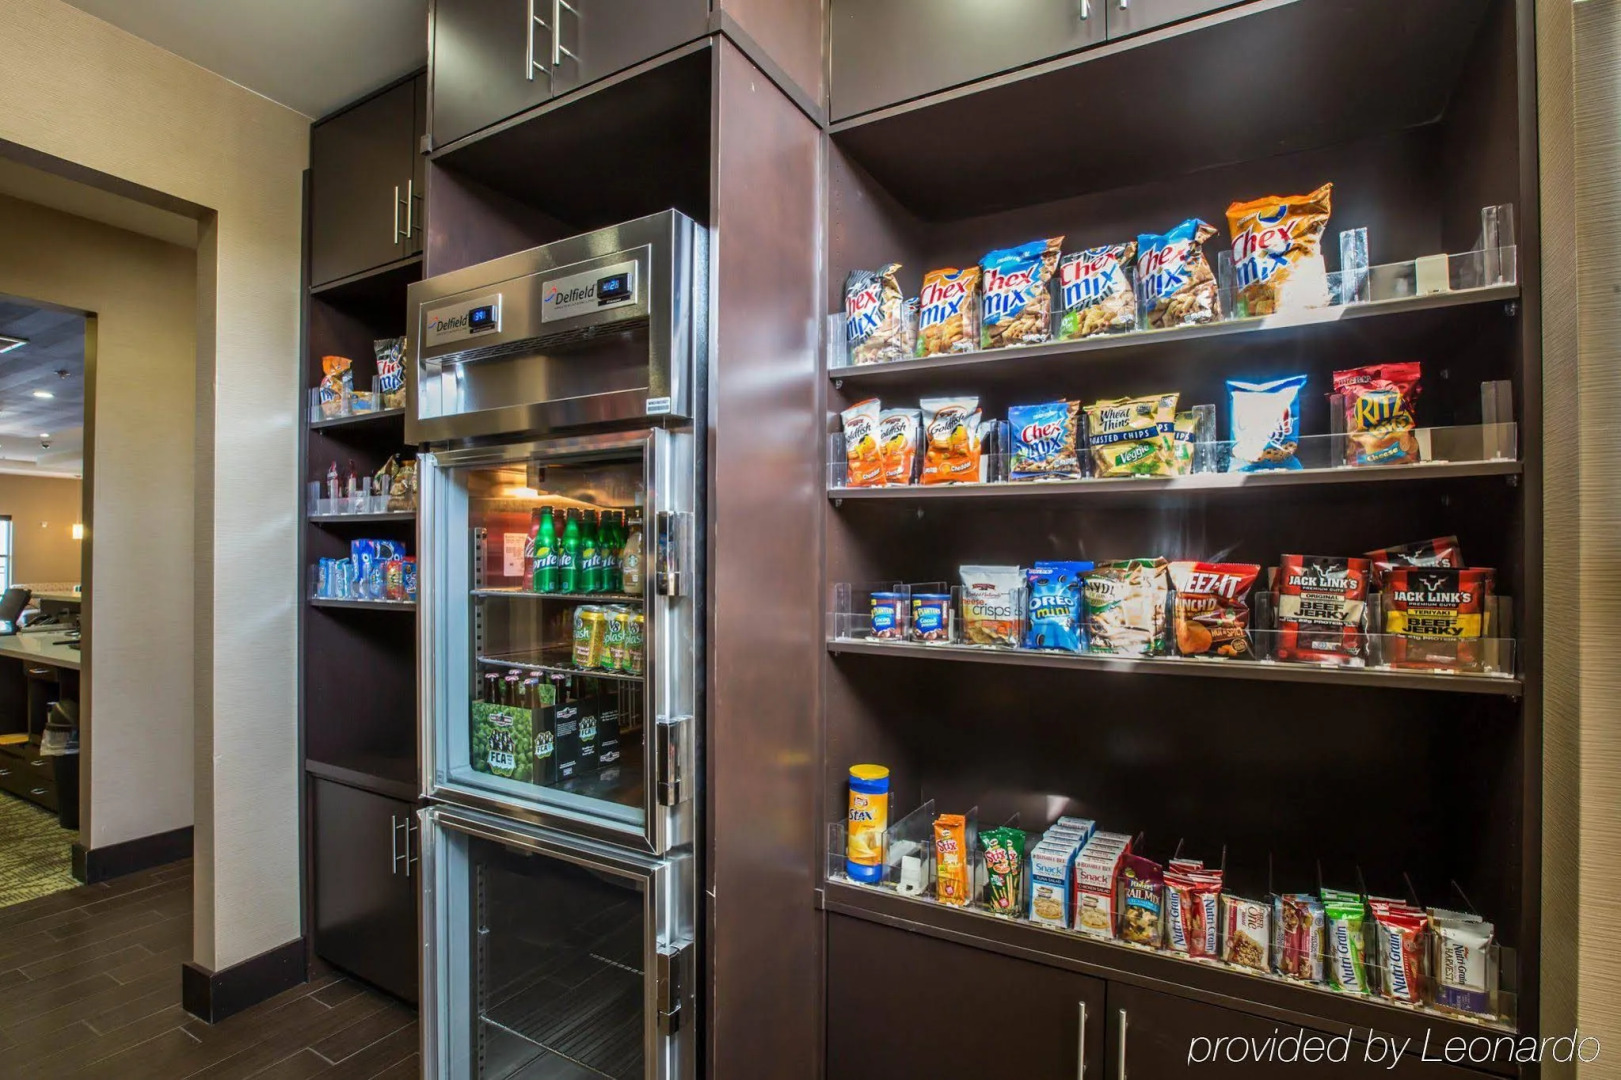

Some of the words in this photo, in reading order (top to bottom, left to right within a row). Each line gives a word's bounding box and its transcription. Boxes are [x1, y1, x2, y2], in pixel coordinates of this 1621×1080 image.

[1231, 216, 1300, 266] Chex
[555, 283, 595, 305] Delfield
[920, 277, 974, 310] Chex
[436, 314, 468, 332] Delfield
[1101, 407, 1131, 421] Wheat
[1355, 394, 1405, 432] RITZ
[931, 413, 966, 435] Goldfish
[1022, 419, 1064, 444] Chex
[1100, 418, 1130, 432] Thins
[846, 423, 872, 445] oldfish
[1123, 429, 1150, 440] CHIPS
[1120, 445, 1150, 464] Veggie
[1289, 575, 1317, 587] JACK
[1320, 577, 1358, 590] LINK'S
[963, 597, 985, 606] heese
[1029, 595, 1074, 610] OREO
[1394, 591, 1425, 602] JACK
[1427, 591, 1472, 603] LINK'S
[972, 603, 1011, 620] crisps
[1036, 607, 1070, 619] mini
[1300, 601, 1344, 611] BEEF
[1293, 610, 1349, 621] JERKY
[1408, 618, 1458, 627] BEEF
[1402, 626, 1464, 636] JERKY
[537, 744, 548, 752] FCA
[490, 751, 507, 765] FCA
[936, 838, 957, 852] Stix
[985, 849, 1005, 863] Stix
[1035, 862, 1063, 875] Snack
[1080, 871, 1109, 884] Snack
[1127, 889, 1142, 899] RAIL
[1171, 892, 1180, 919] Grain
[1204, 898, 1215, 924] Nutri
[1247, 906, 1257, 930] One
[1172, 918, 1186, 947] Nutri
[1206, 924, 1216, 952] Grain
[1337, 926, 1349, 955] Grain
[1389, 932, 1401, 963] Grain
[1339, 956, 1358, 986] Nutri
[1391, 963, 1409, 995] Nutri
